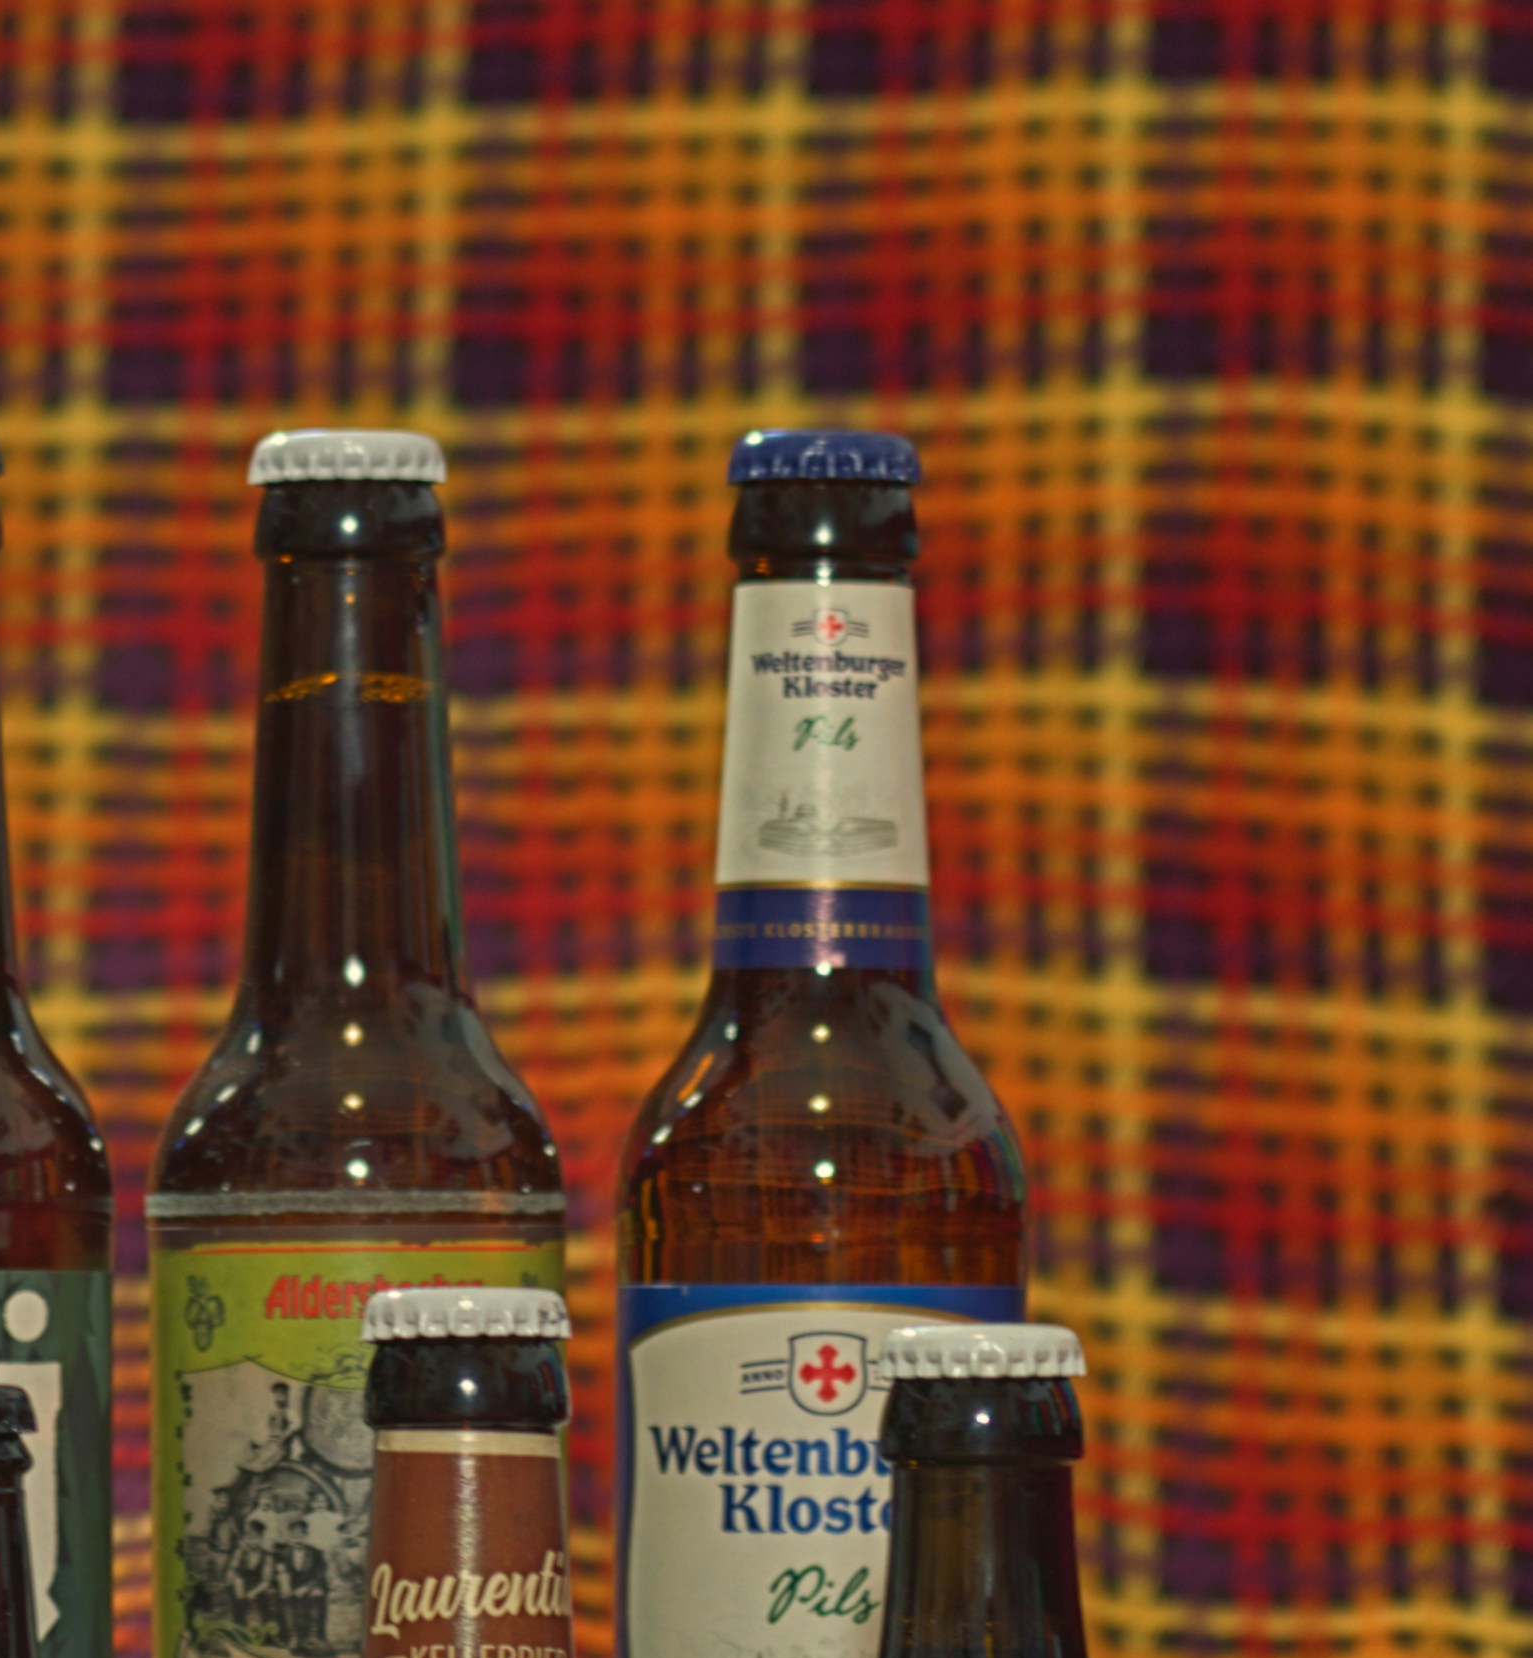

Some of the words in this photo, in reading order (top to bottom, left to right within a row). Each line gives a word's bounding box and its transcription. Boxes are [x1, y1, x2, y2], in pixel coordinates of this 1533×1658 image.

[751, 651, 906, 681] Weltenburger
[783, 675, 878, 699] Kloster
[793, 715, 860, 751] Pils
[648, 1425, 892, 1477] Weltenbu
[767, 1563, 881, 1625] Pils
